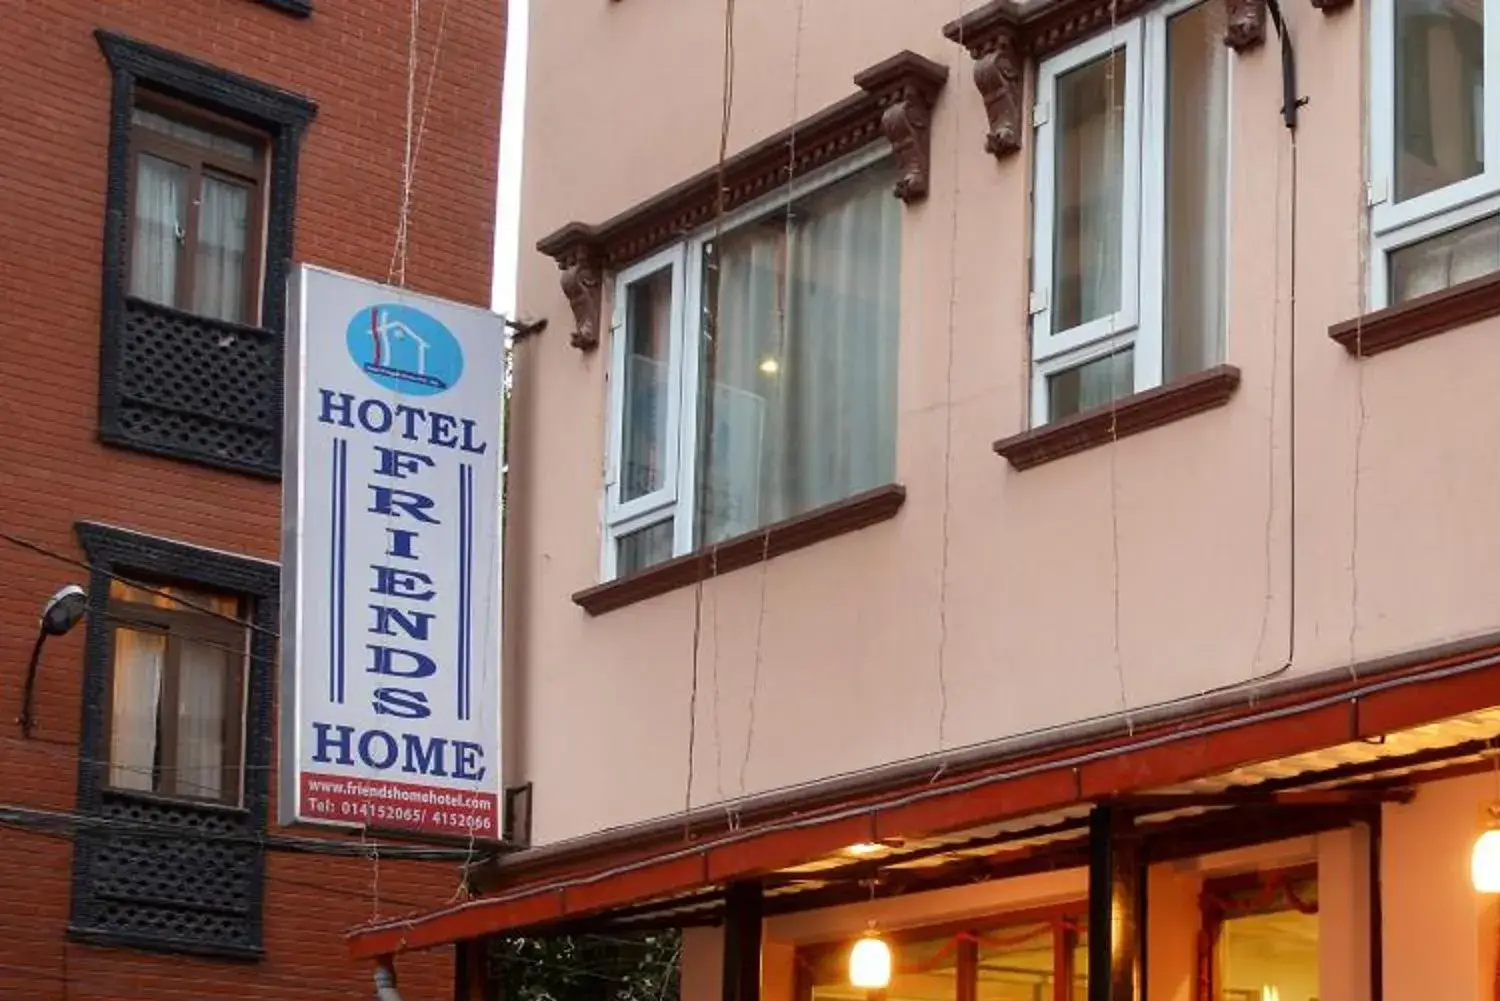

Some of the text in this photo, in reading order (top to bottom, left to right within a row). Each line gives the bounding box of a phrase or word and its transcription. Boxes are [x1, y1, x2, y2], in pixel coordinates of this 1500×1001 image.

[318, 388, 488, 455] HOTEL
[365, 445, 441, 721] FRIENDS
[311, 721, 487, 782] HOME
[308, 780, 491, 809] www.friendshomehotel.com
[308, 797, 335, 813] Tel:
[432, 811, 491, 830] 4152066
